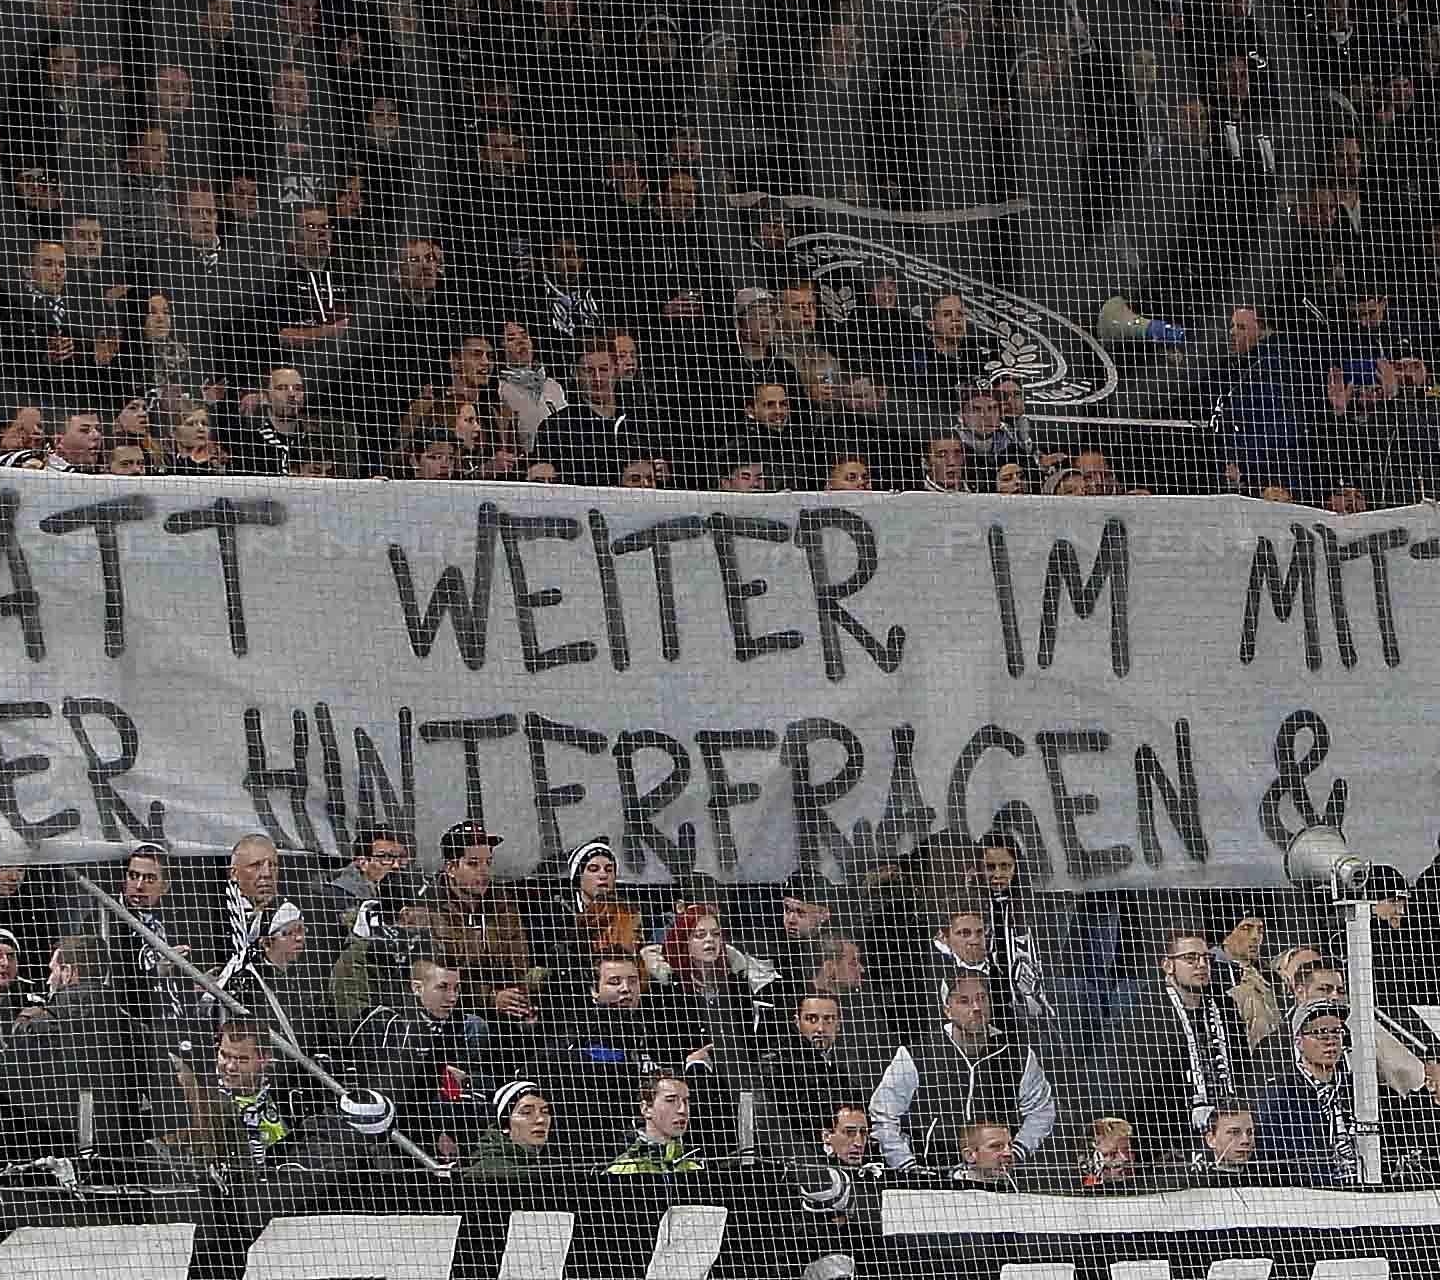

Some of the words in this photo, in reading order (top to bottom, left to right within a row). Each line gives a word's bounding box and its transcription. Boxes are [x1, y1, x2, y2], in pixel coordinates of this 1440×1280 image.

[386, 499, 906, 680] WEITER
[986, 516, 1130, 678] IM
[242, 700, 1212, 892] HINTERFRAGEN
[1258, 708, 1348, 856] &
